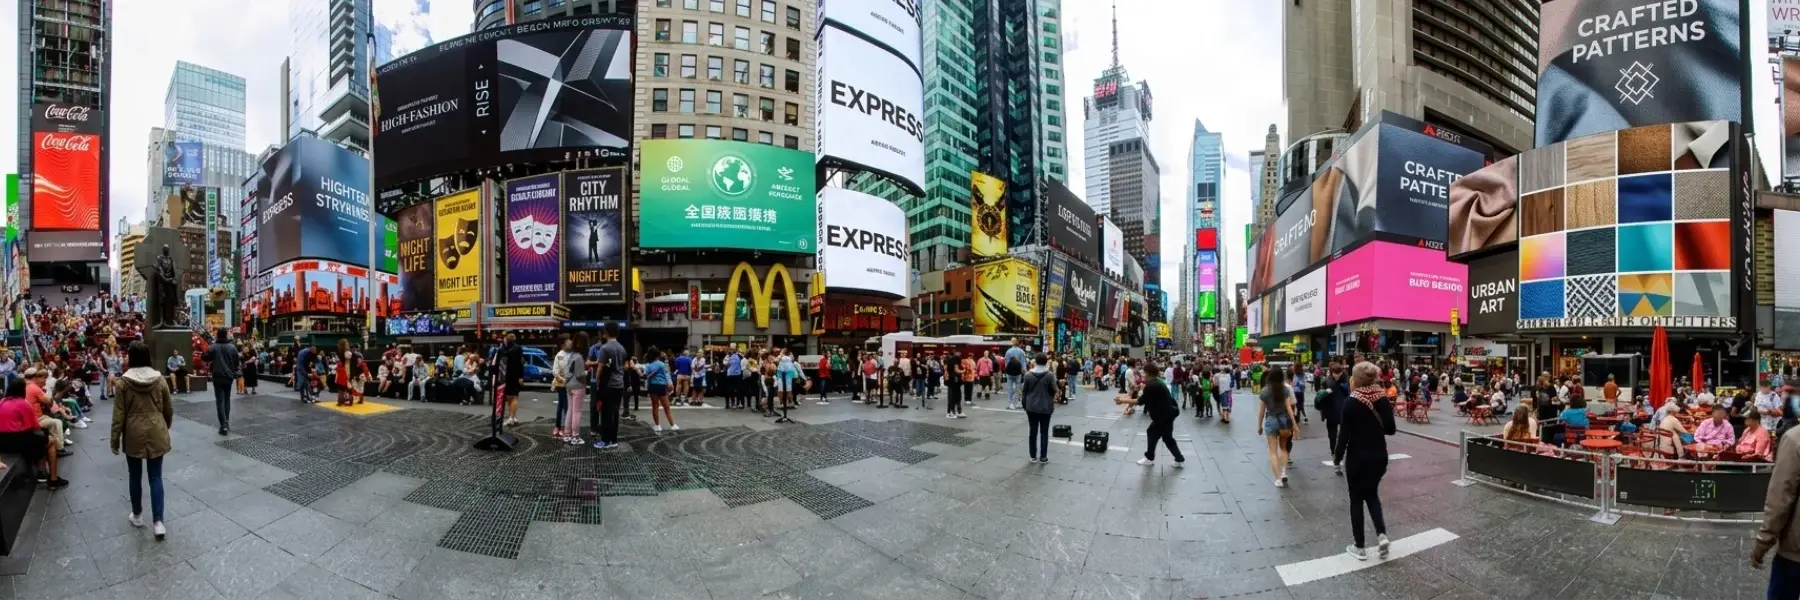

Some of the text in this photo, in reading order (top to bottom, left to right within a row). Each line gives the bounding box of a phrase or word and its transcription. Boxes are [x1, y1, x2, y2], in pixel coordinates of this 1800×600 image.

[1577, 0, 1698, 37] CRAFTED
[1572, 20, 1706, 63] PATTERNS
[474, 79, 490, 117] RISE
[831, 79, 924, 143] EXPRESS
[579, 180, 607, 196] CITY
[569, 194, 619, 212] RHYTHM
[827, 224, 909, 262] EXPRESS
[404, 255, 426, 273] LIFE
[462, 275, 478, 288] LIFE
[569, 269, 620, 283] NIGHT LIFE
[1471, 277, 1516, 299] URBAN
[1479, 297, 1506, 315] ART
